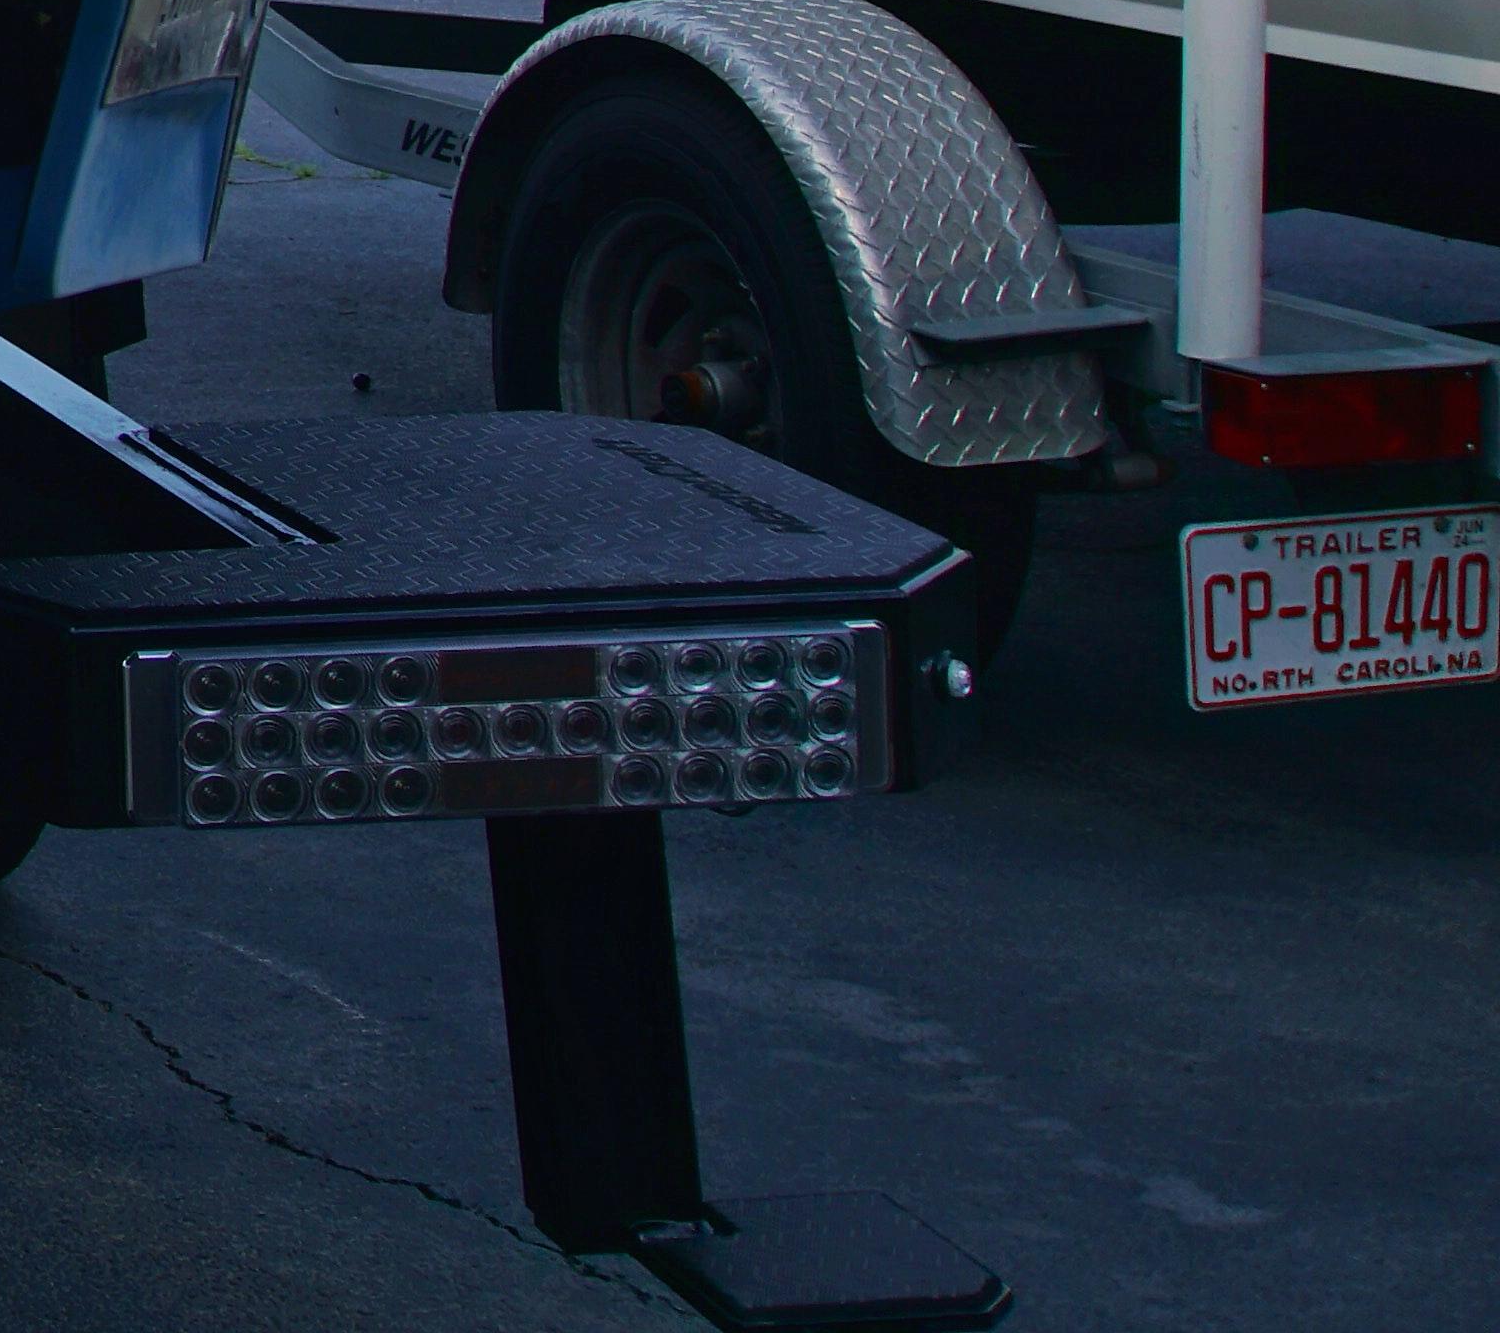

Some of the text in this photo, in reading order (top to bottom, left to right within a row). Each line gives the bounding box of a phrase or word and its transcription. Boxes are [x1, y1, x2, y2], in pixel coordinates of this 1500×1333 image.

[1274, 527, 1422, 559] TRAILER
[1203, 552, 1490, 662] CP-81440
[1212, 650, 1483, 697] NORTH CAROLINA
